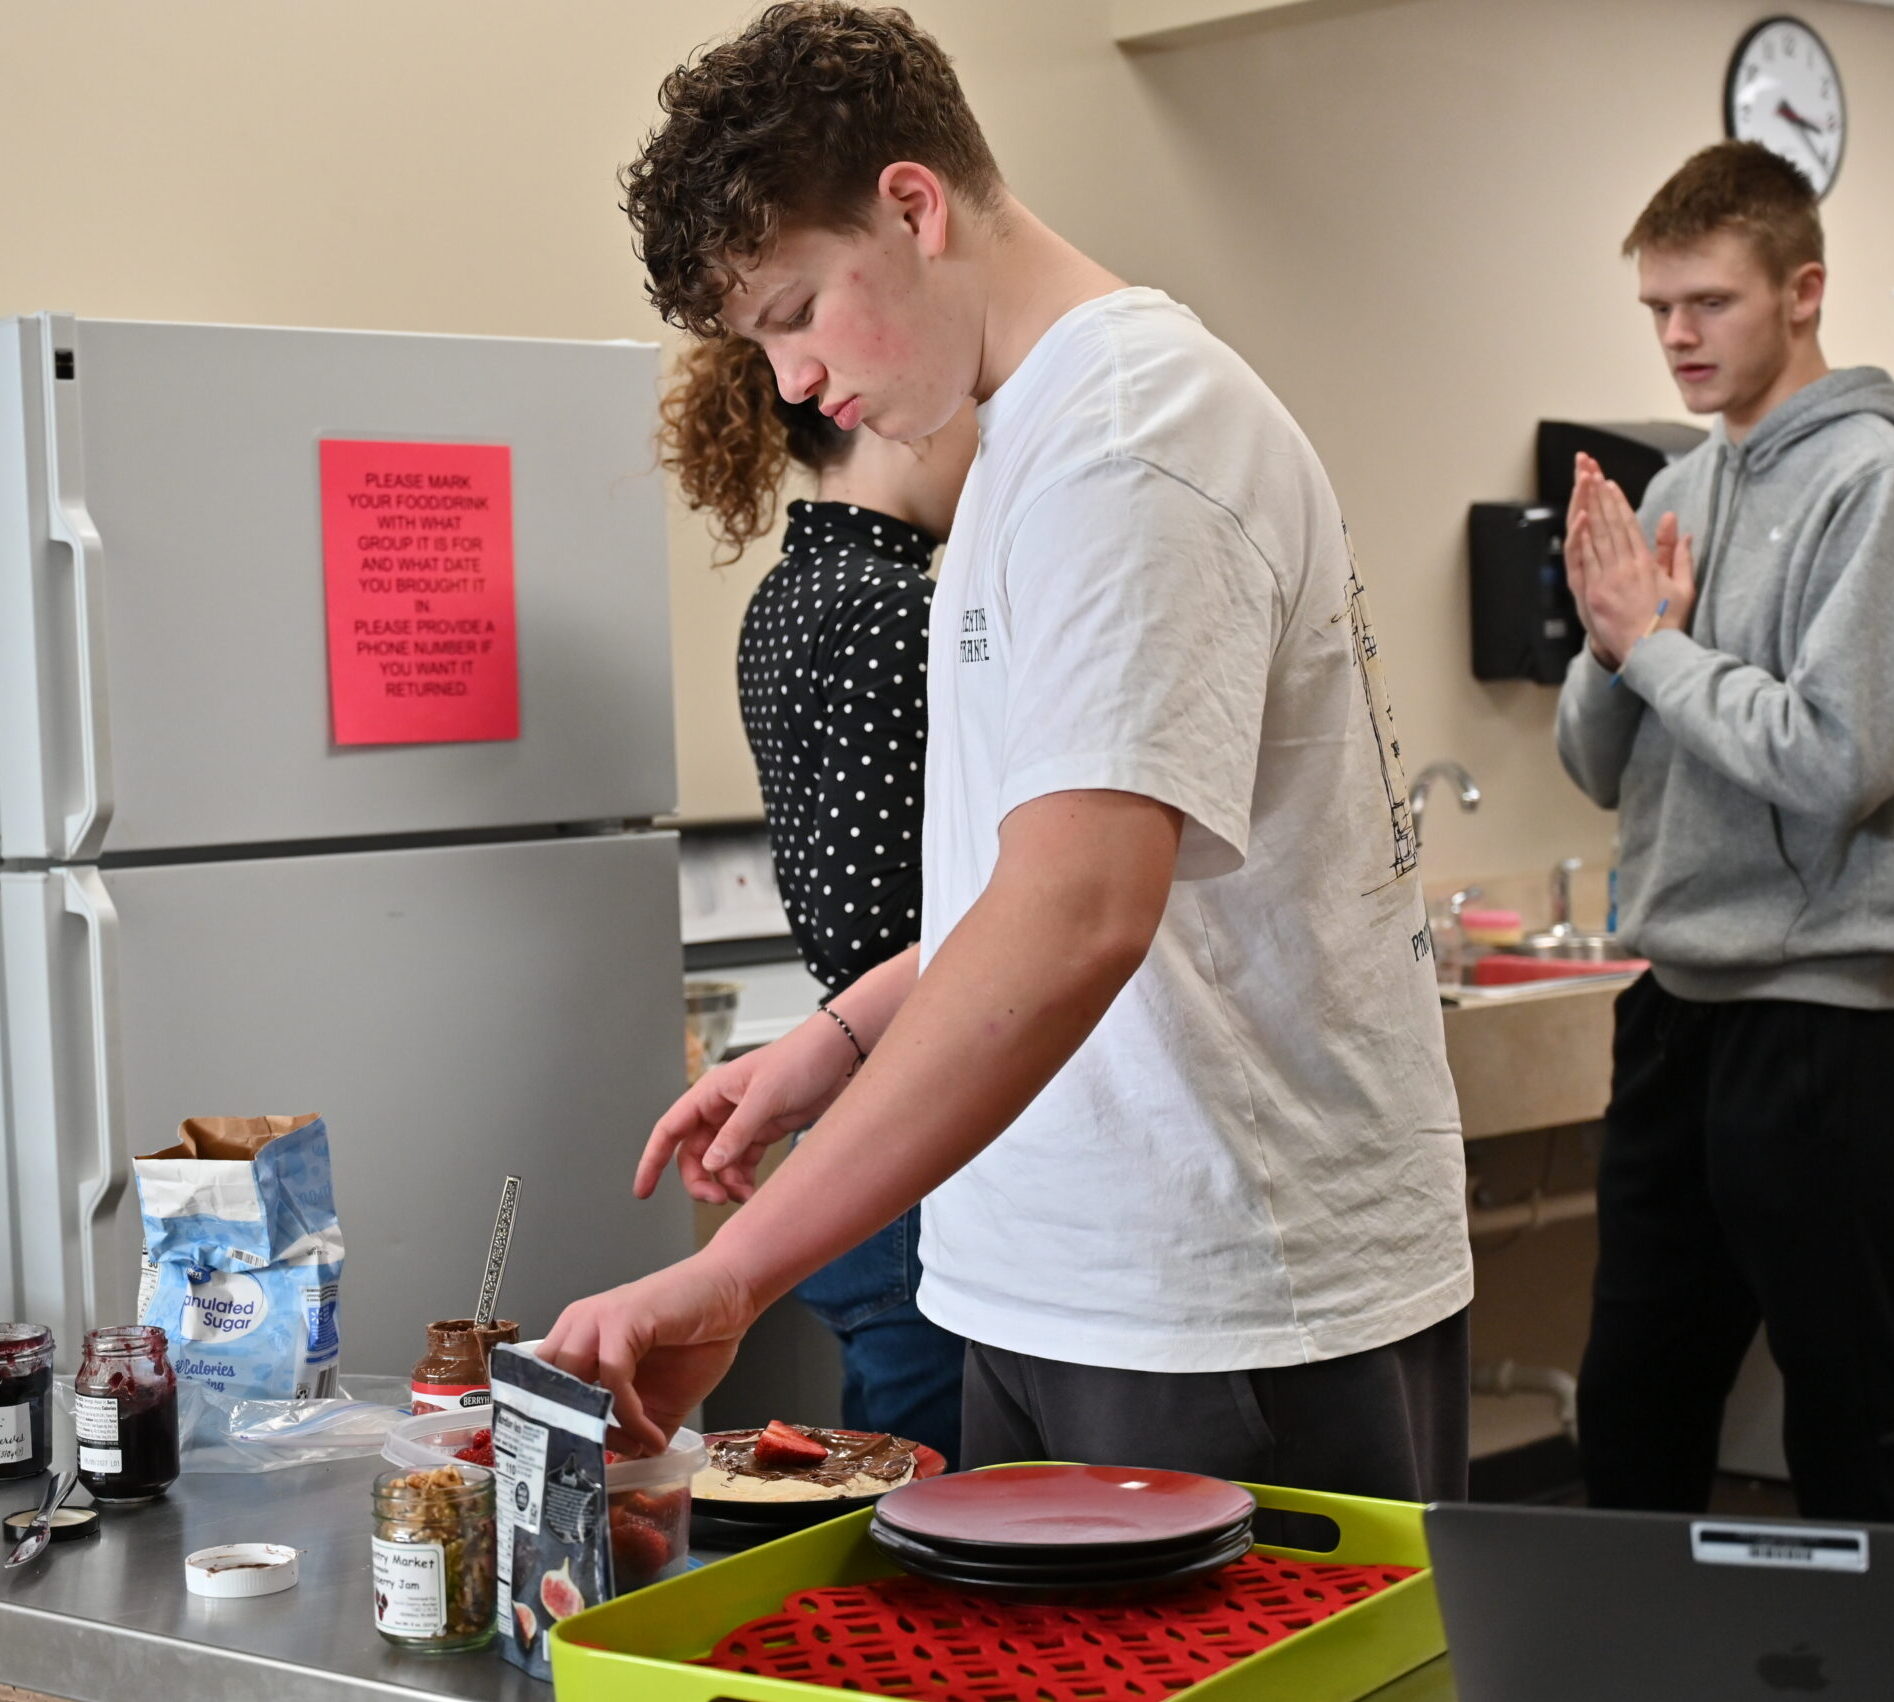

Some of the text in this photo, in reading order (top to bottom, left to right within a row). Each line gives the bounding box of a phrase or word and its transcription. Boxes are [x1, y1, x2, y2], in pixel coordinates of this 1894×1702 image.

[365, 473, 471, 489] PLEASE MARK
[348, 494, 391, 508] YOUR
[377, 515, 461, 530] WITH WHAT
[358, 535, 482, 551] GROUP IT IS FOR
[361, 557, 481, 572] AND WHAT DATE
[358, 578, 486, 593] YOU BROUGHT IT
[414, 600, 431, 614] IN
[354, 619, 495, 634] PLEASE PROVIDE A
[357, 640, 493, 655] PHONE NUMBER IF
[379, 662, 474, 676] YOU WANT IT
[202, 1313, 252, 1333] Sugar
[463, 1395, 492, 1407] BERRYH
[392, 1554, 435, 1570] Market
[399, 1579, 420, 1590] Jam
